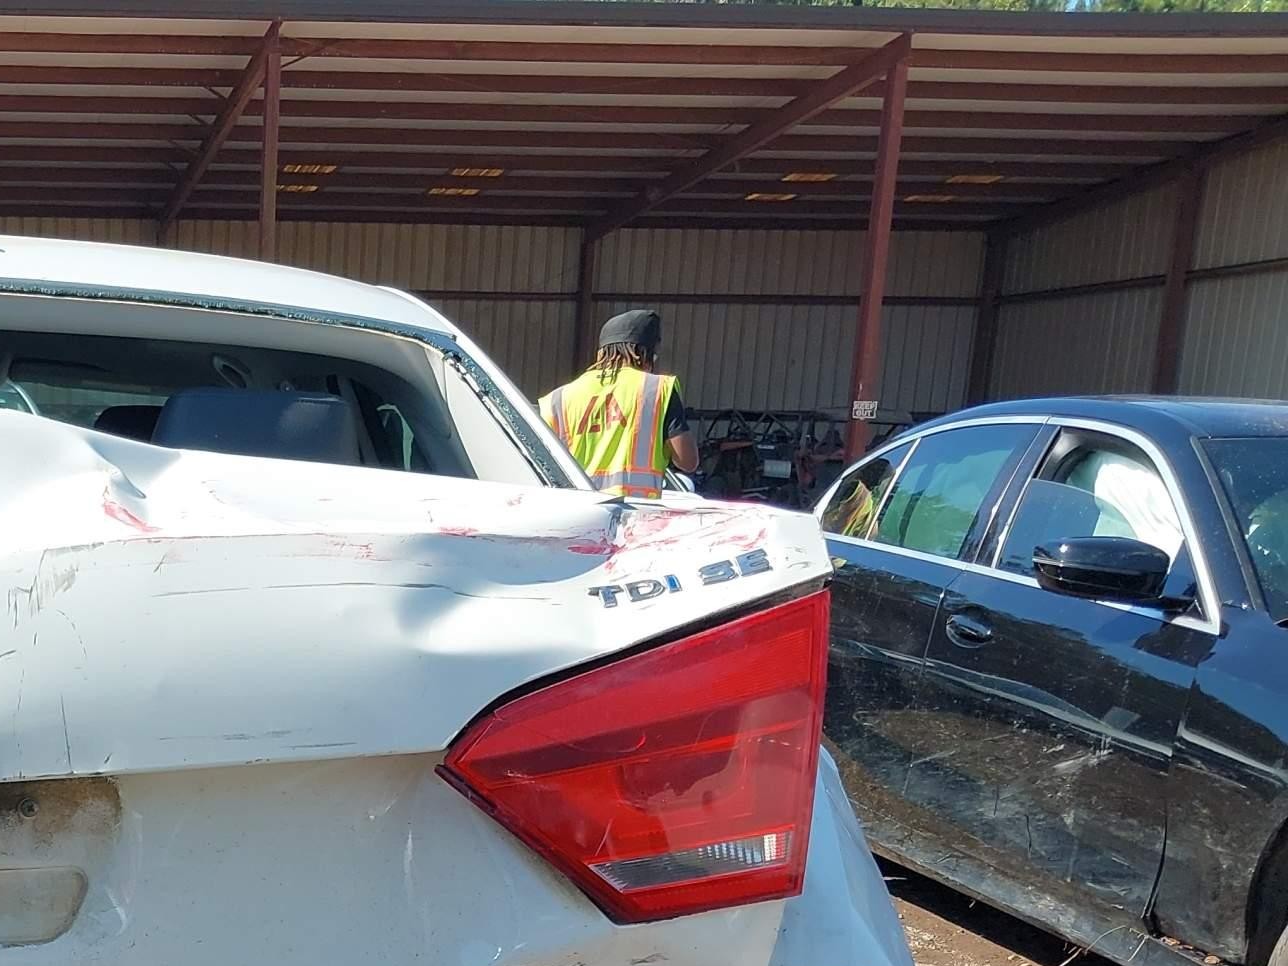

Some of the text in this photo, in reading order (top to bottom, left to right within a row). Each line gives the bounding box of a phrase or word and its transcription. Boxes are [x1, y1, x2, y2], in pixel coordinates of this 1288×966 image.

[855, 409, 872, 417] OUT
[587, 549, 773, 608] TDI SE
